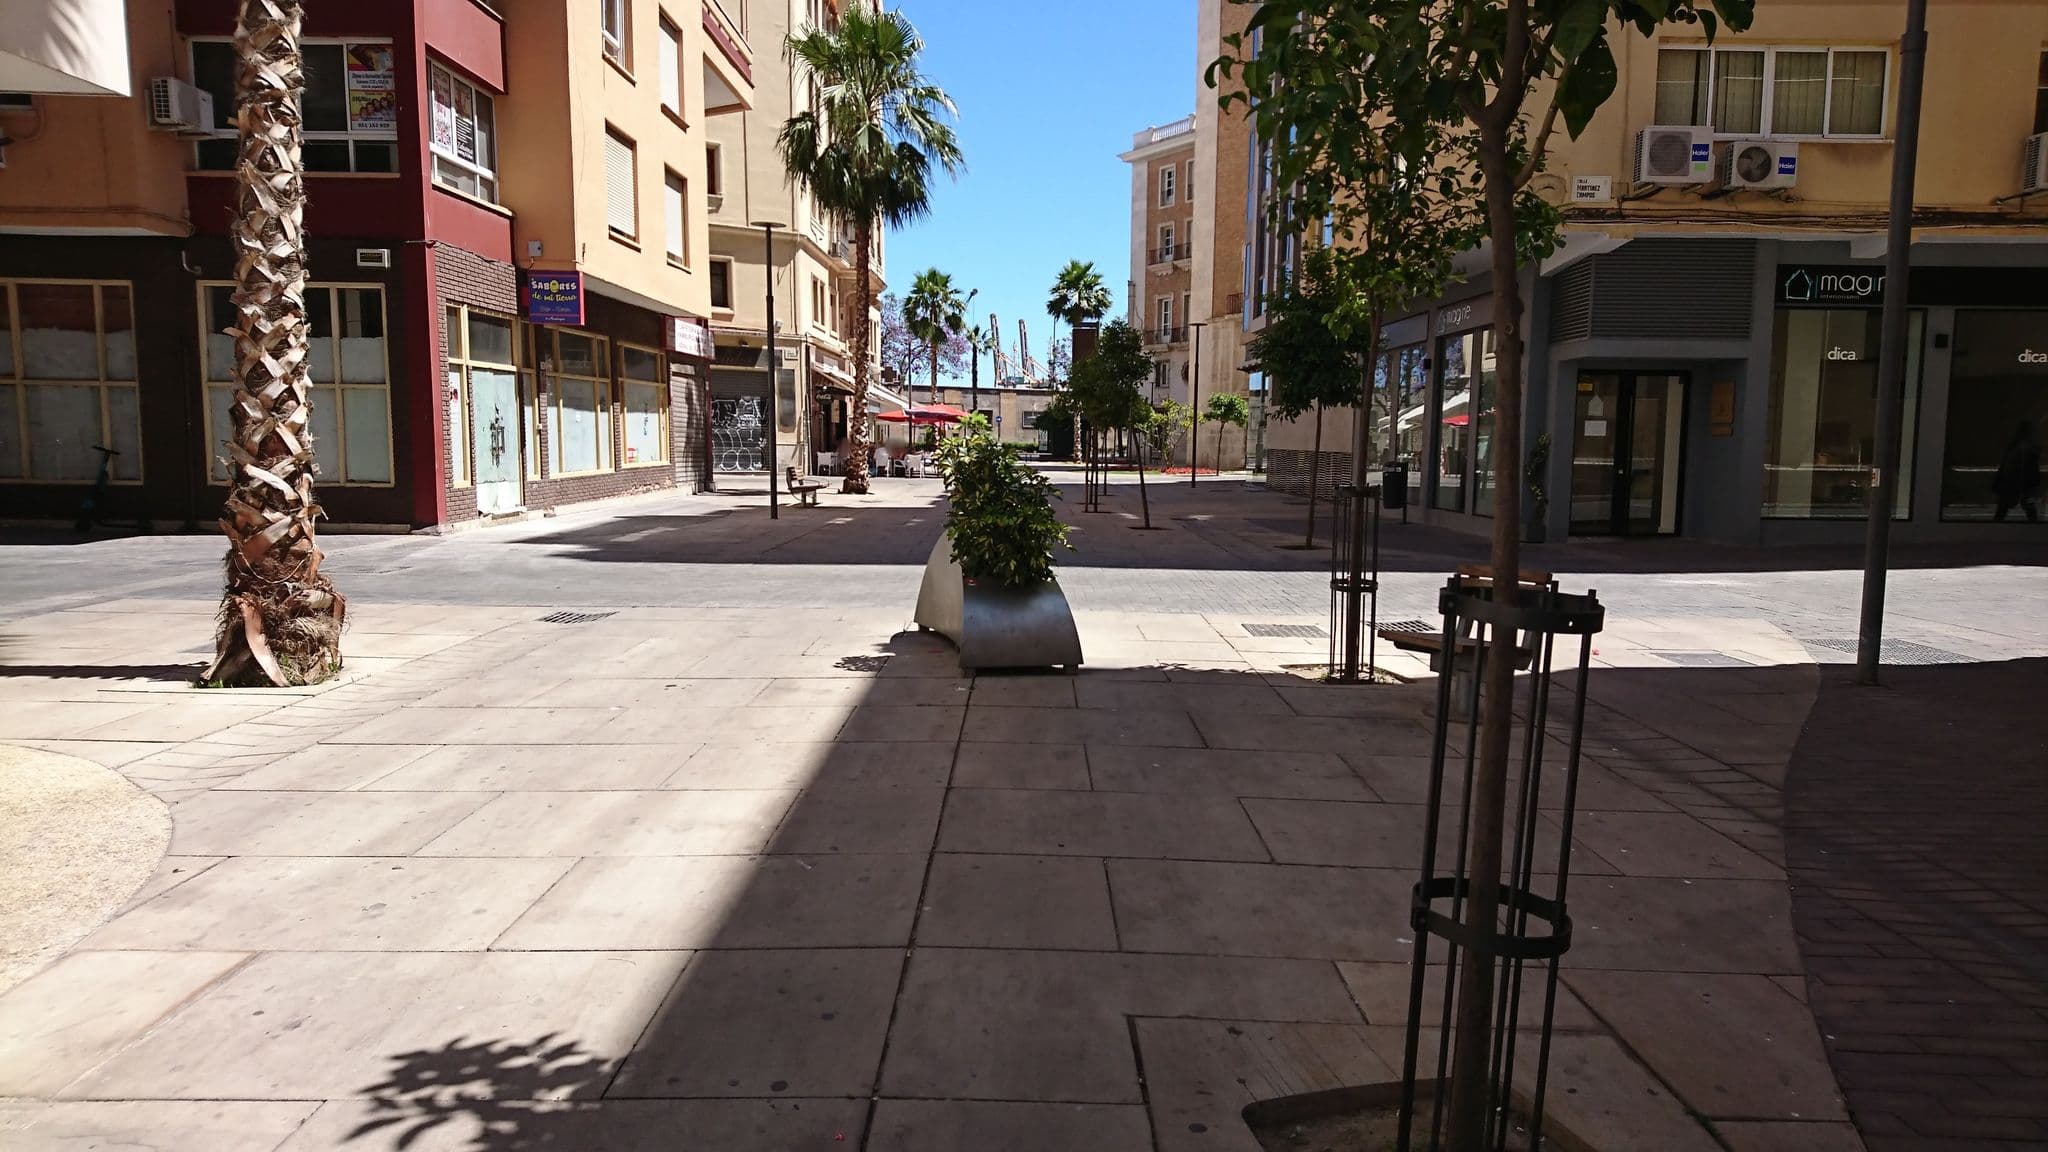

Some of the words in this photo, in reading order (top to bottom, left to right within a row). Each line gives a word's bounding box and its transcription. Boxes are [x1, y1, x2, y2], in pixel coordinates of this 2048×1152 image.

[1692, 149, 1709, 157] Haier
[531, 280, 577, 293] SABORES
[532, 292, 543, 300] de
